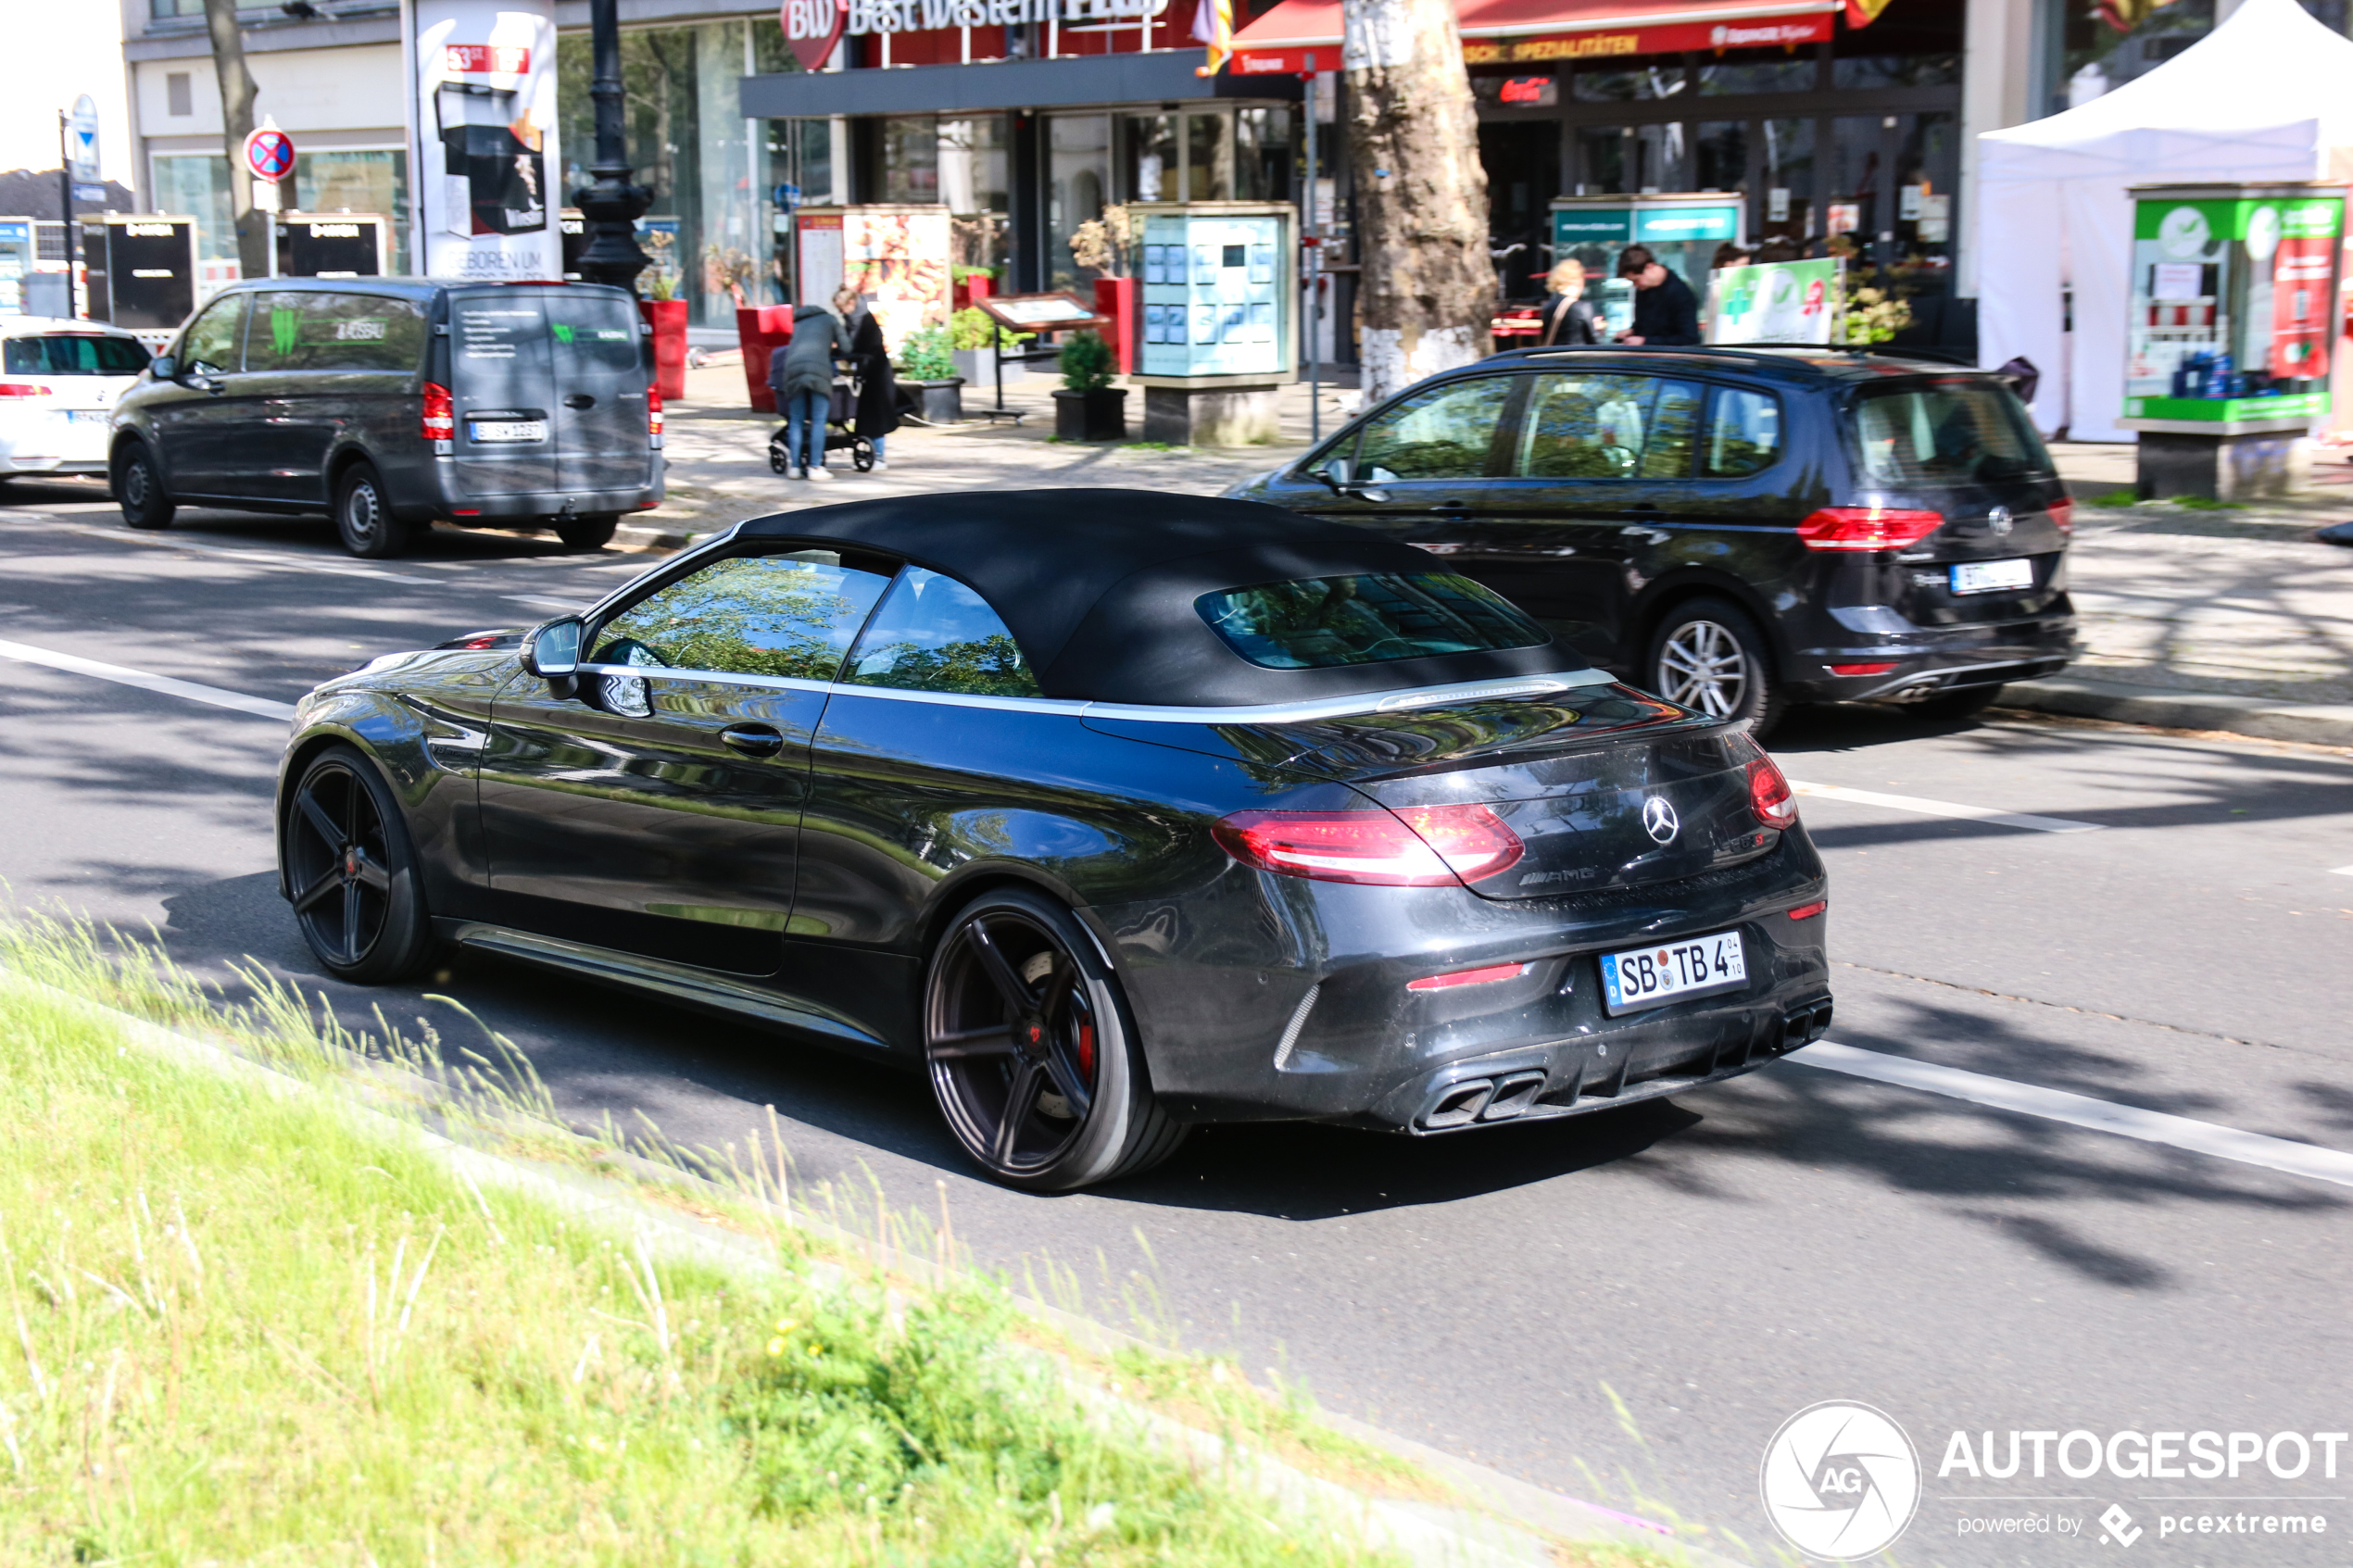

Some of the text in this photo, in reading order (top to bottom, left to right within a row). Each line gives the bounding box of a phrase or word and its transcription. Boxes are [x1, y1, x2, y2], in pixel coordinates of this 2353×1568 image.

[788, 0, 835, 40] BW
[848, 0, 917, 34] Best
[447, 47, 472, 70] 53
[447, 250, 542, 270] GEBOREN UM
[432, 745, 446, 755] V8
[1544, 867, 1594, 883] AMG
[1609, 939, 1729, 997] D SB TB 4
